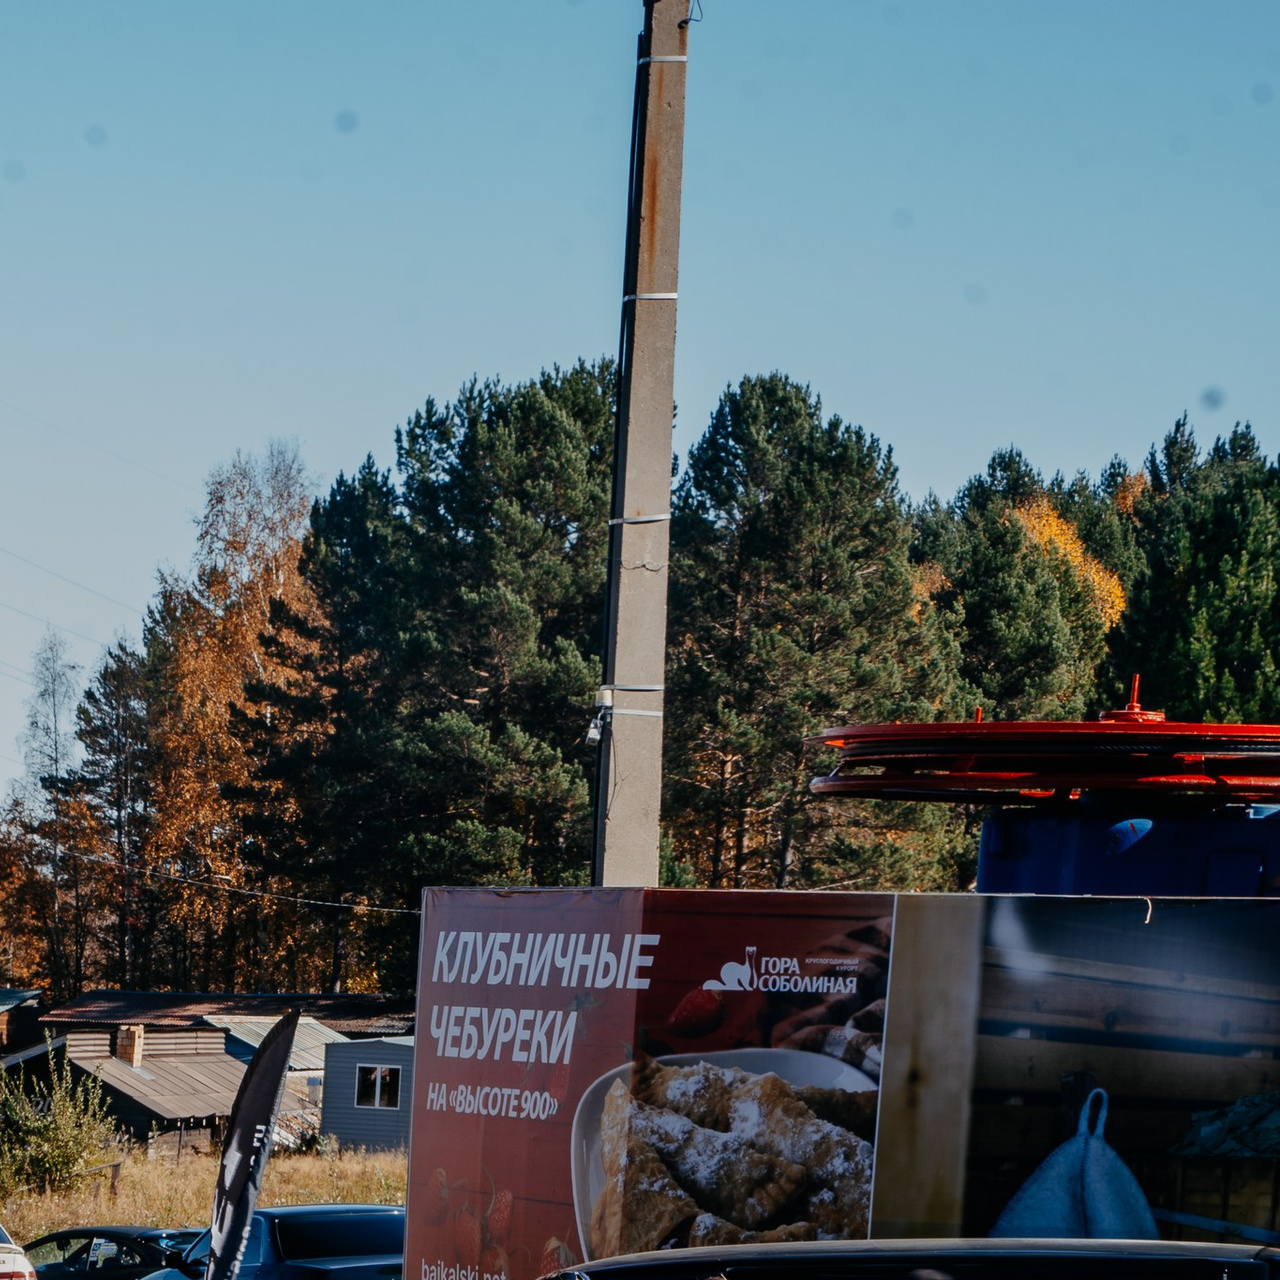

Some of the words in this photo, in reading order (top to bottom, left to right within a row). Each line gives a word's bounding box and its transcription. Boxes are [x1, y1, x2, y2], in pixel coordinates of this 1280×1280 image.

[431, 931, 661, 990] КЛУБНИЧНЫЕ
[760, 957, 800, 974] ГОРА
[758, 975, 858, 993] СОБОЛИНАЯ
[430, 1005, 578, 1065] ЧЕБУРЕКИ
[426, 1082, 447, 1111] НА
